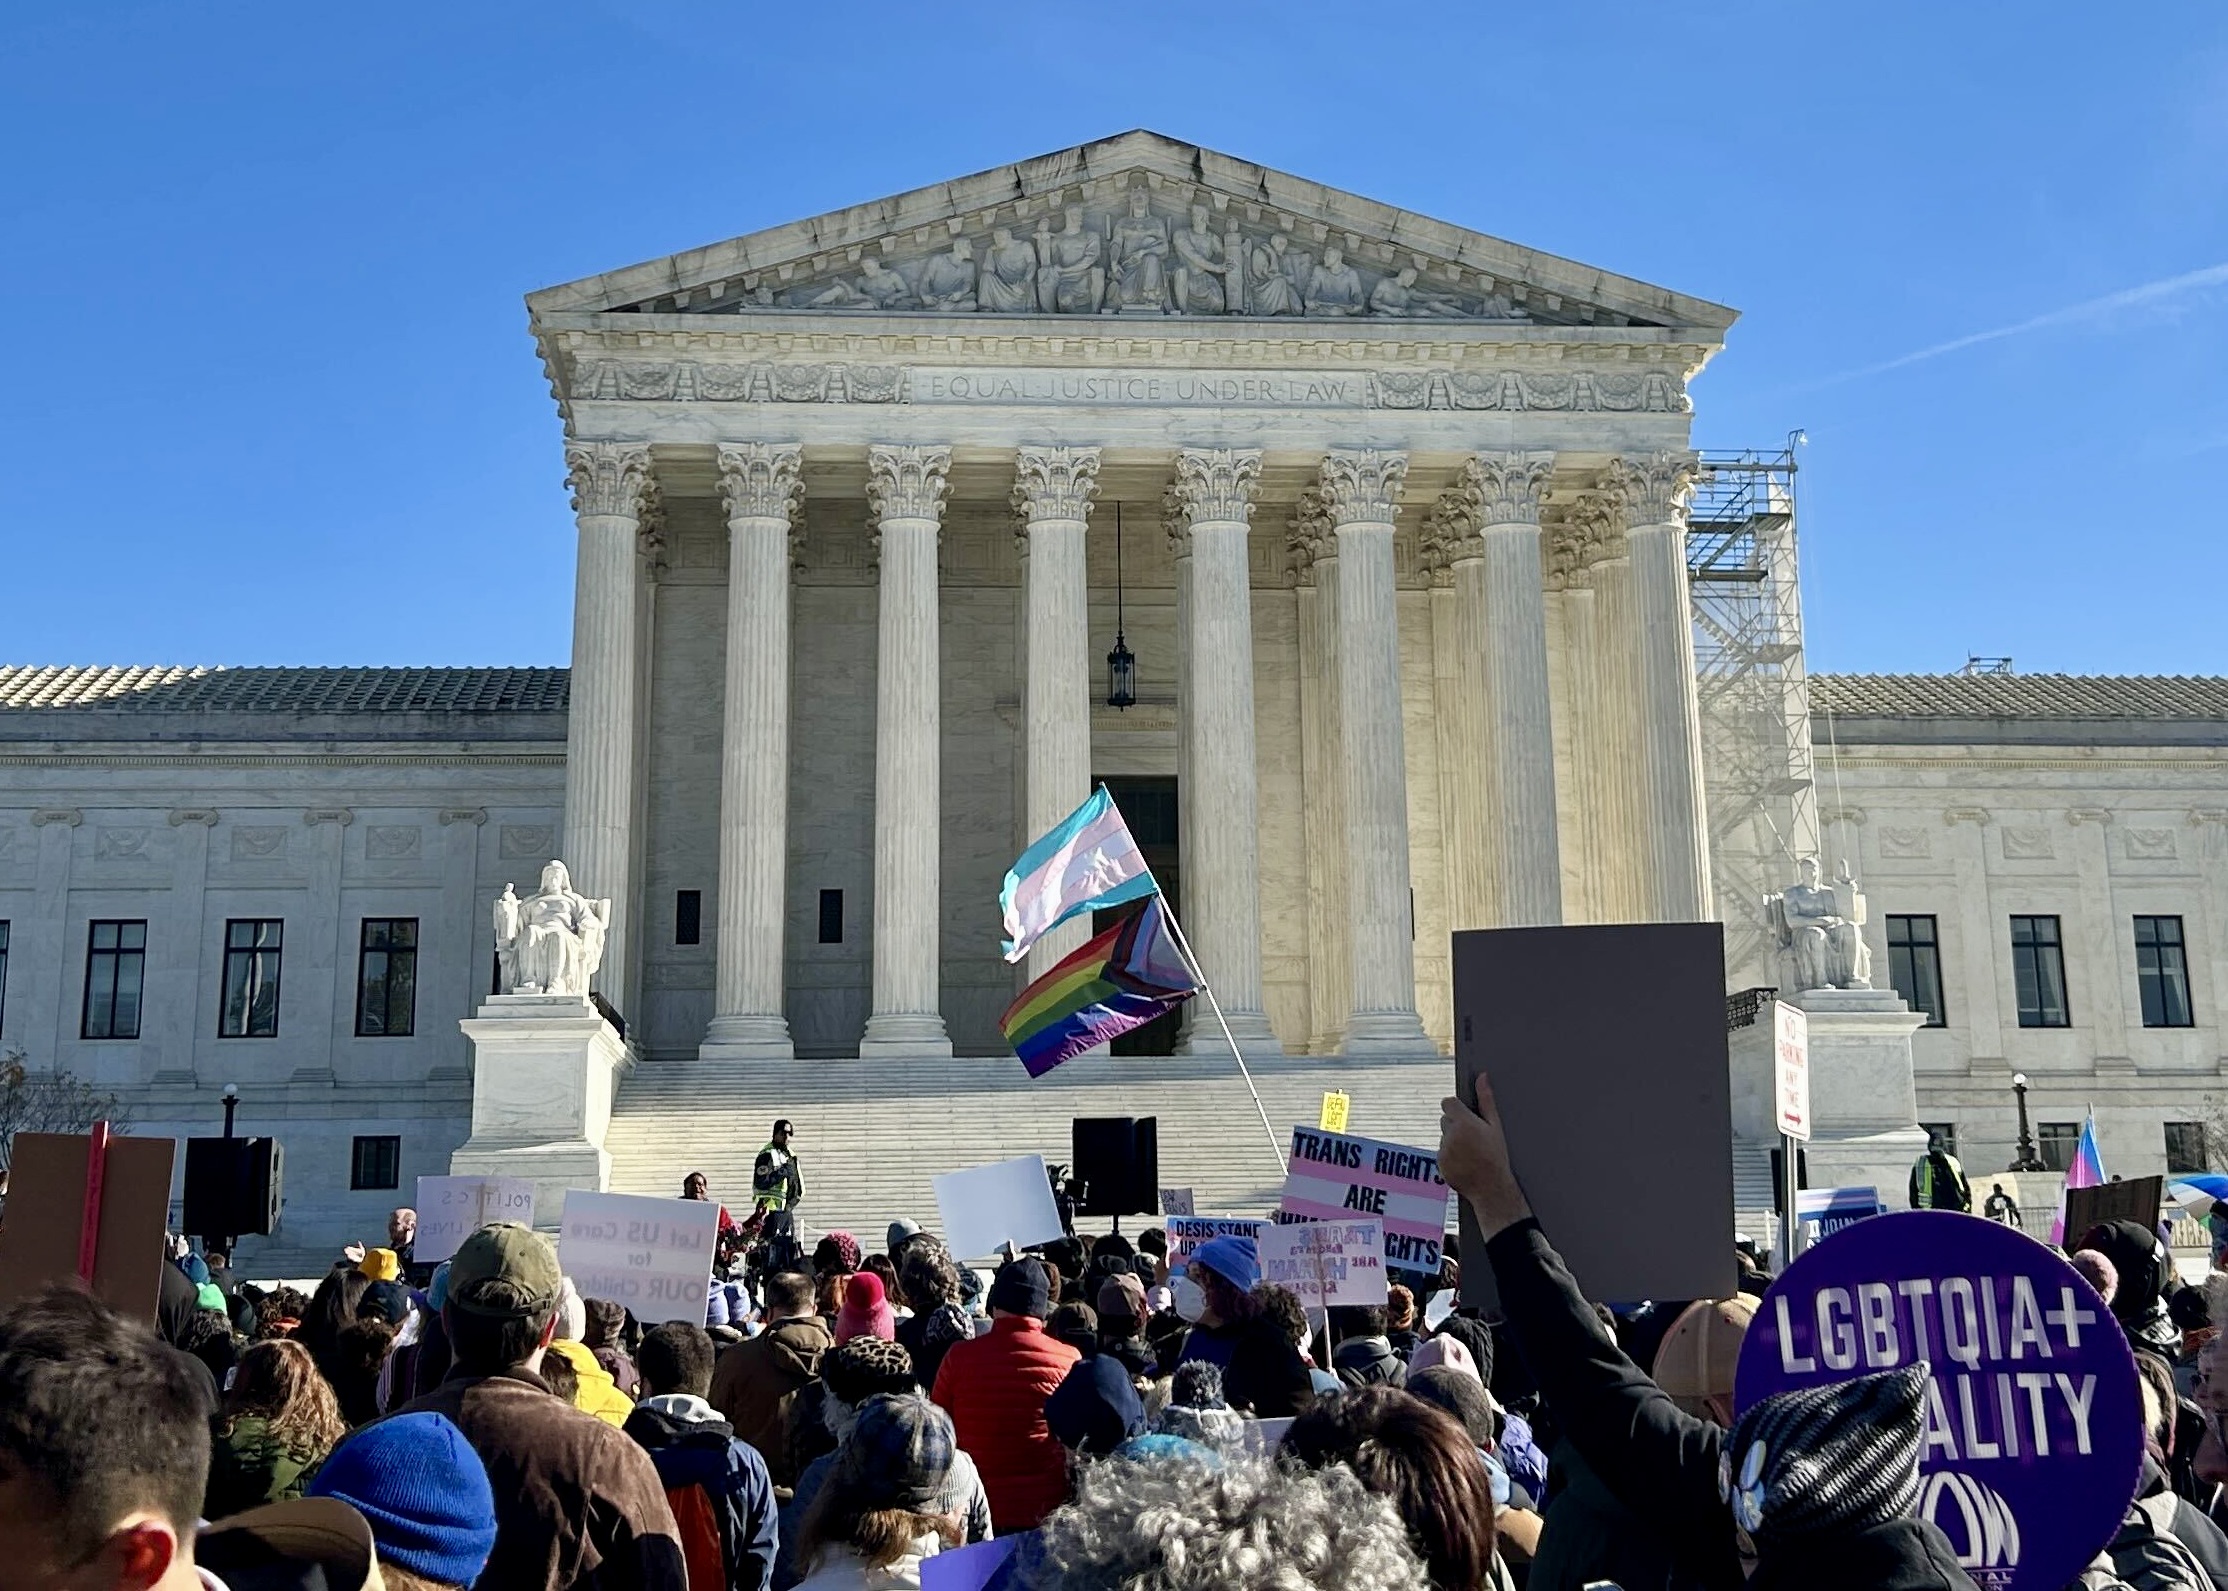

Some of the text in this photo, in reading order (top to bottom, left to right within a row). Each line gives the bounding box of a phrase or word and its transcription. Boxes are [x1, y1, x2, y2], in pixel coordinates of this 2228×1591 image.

[931, 376, 1346, 401] EQUAL JUSTICE UNDER LAW
[1293, 1131, 1362, 1169] TRANS
[1343, 1184, 1388, 1215] ARE
[1176, 1220, 1214, 1238] DESIS
[1383, 1231, 1440, 1266] GHTS
[1774, 1275, 2097, 1375] LGBTQIA+
[1918, 1372, 2098, 1462] ALITY
